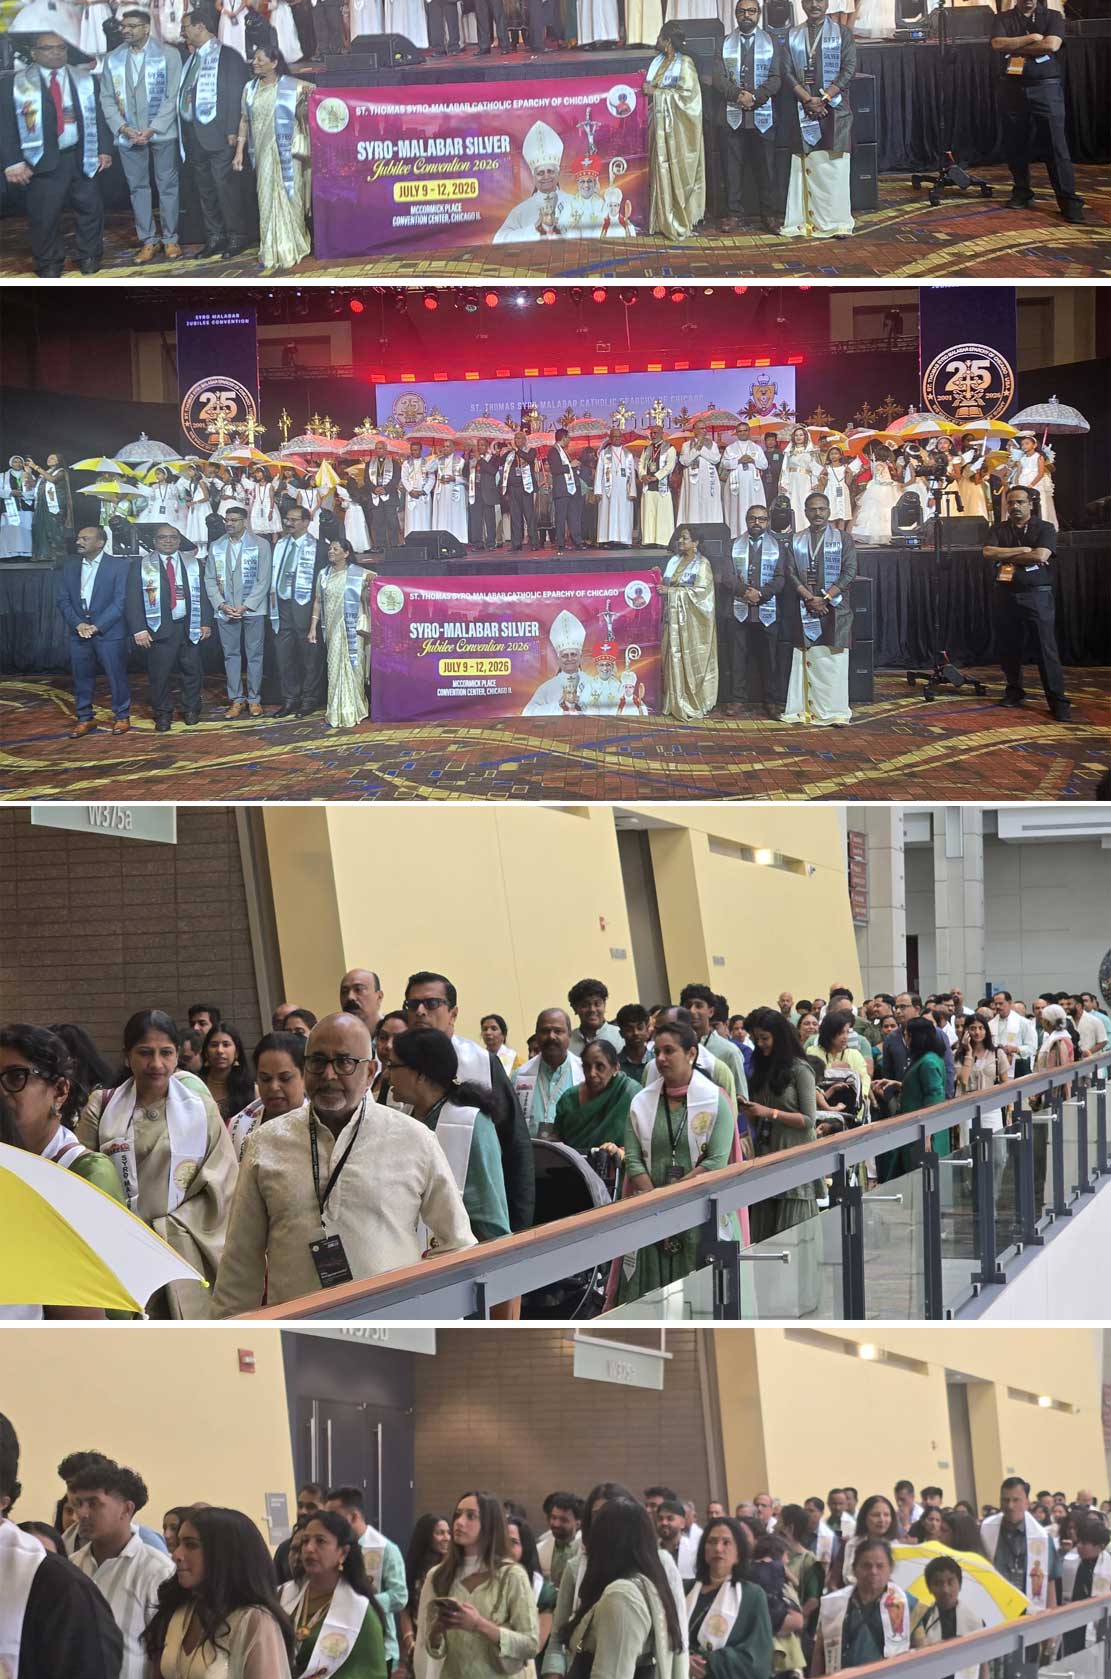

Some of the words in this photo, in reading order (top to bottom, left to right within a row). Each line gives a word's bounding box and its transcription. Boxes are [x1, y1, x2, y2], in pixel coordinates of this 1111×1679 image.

[355, 106, 369, 116] ST.
[370, 105, 405, 115] THOMAS
[406, 102, 470, 114] SYRO-MALABAR
[471, 100, 512, 112] CATHOLIC
[513, 98, 550, 109] EPARCHY
[551, 97, 562, 106] OF
[563, 95, 600, 106] CHICAGO
[357, 139, 464, 160] SYRO-MALABAR
[465, 135, 510, 154] SILVER
[367, 159, 411, 182] Jubilee
[413, 157, 471, 175] Convention
[472, 159, 499, 171] 2026
[399, 184, 420, 198] JULY
[421, 184, 428, 197] 9
[437, 183, 450, 197] 12,
[452, 182, 476, 195] 2026
[445, 203, 462, 212] PLACE
[392, 215, 428, 227] CONVENTION
[428, 213, 450, 225] CENTER,
[451, 212, 475, 222] CHICAGO
[945, 359, 992, 392] 25
[199, 391, 238, 420] 25
[484, 401, 515, 411] THOMAS
[409, 592, 421, 600] ST.
[422, 592, 451, 600] THOMAS
[452, 592, 506, 600] SYRO-MALABAR
[507, 591, 541, 599] CATHOLIC
[542, 590, 575, 599] EPARCHY
[576, 589, 585, 597] OF
[586, 589, 619, 597] CHICAGO
[410, 622, 499, 638] SYRO-MALABAR
[501, 621, 539, 637] SILVER
[417, 639, 454, 657] Jubilee
[456, 638, 505, 653] Convention
[506, 642, 529, 652] 2026
[443, 661, 462, 673] JULY
[463, 661, 468, 672] 9
[476, 661, 487, 674] 12,
[488, 661, 509, 672] 2026
[482, 679, 496, 687] PLACE
[437, 689, 467, 697] CONVENTION
[467, 688, 486, 696] CENTER,
[487, 687, 507, 695] CHICAGO
